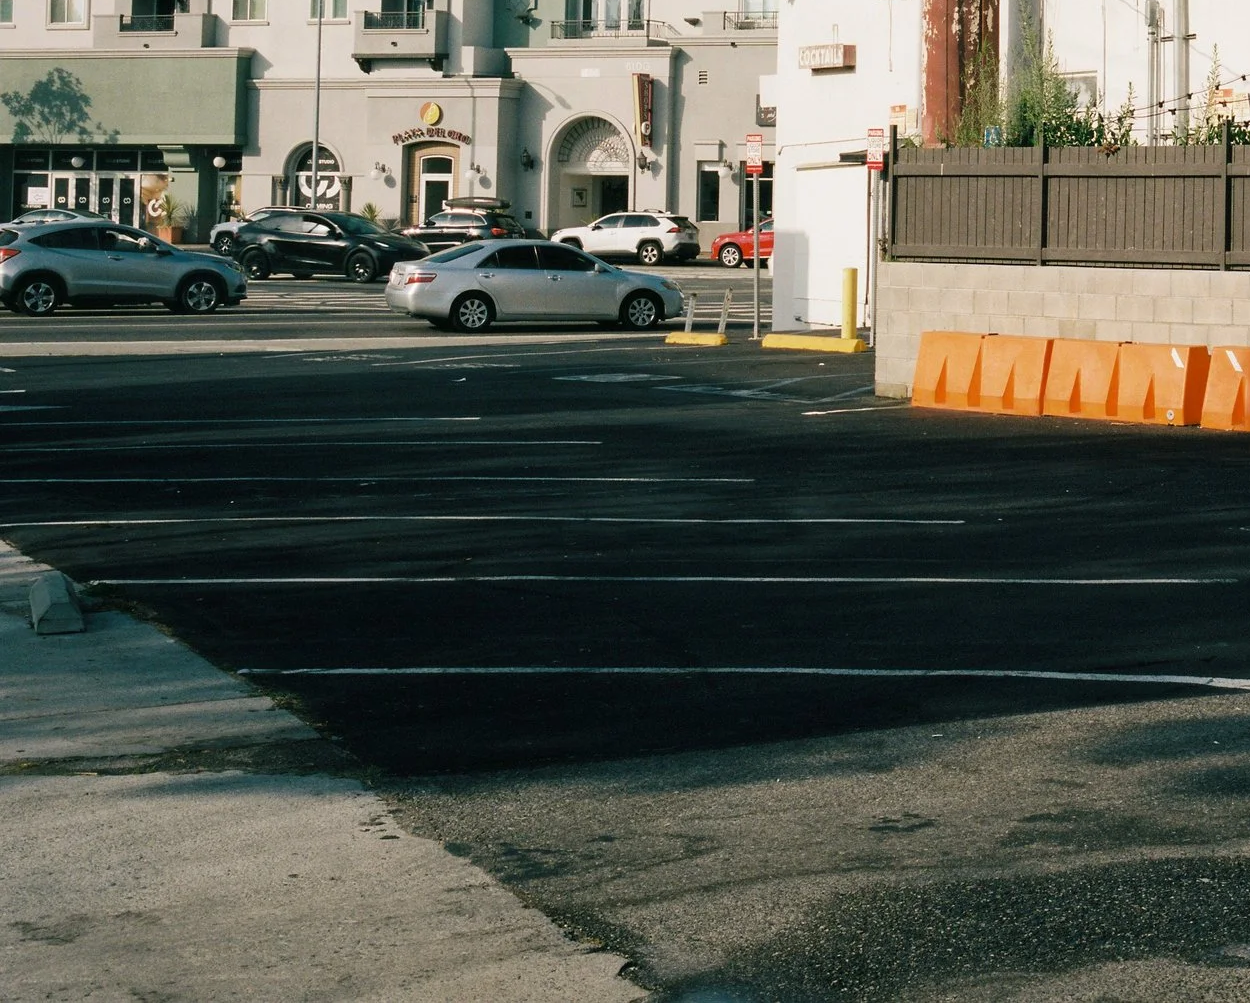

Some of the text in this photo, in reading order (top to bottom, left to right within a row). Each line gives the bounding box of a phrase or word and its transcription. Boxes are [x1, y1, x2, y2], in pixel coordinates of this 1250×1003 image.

[799, 47, 843, 66] COCKTAILS
[392, 127, 471, 146] PLAYA DEL ORO
[748, 157, 761, 165] ONLY
[868, 152, 882, 161] ONLY
